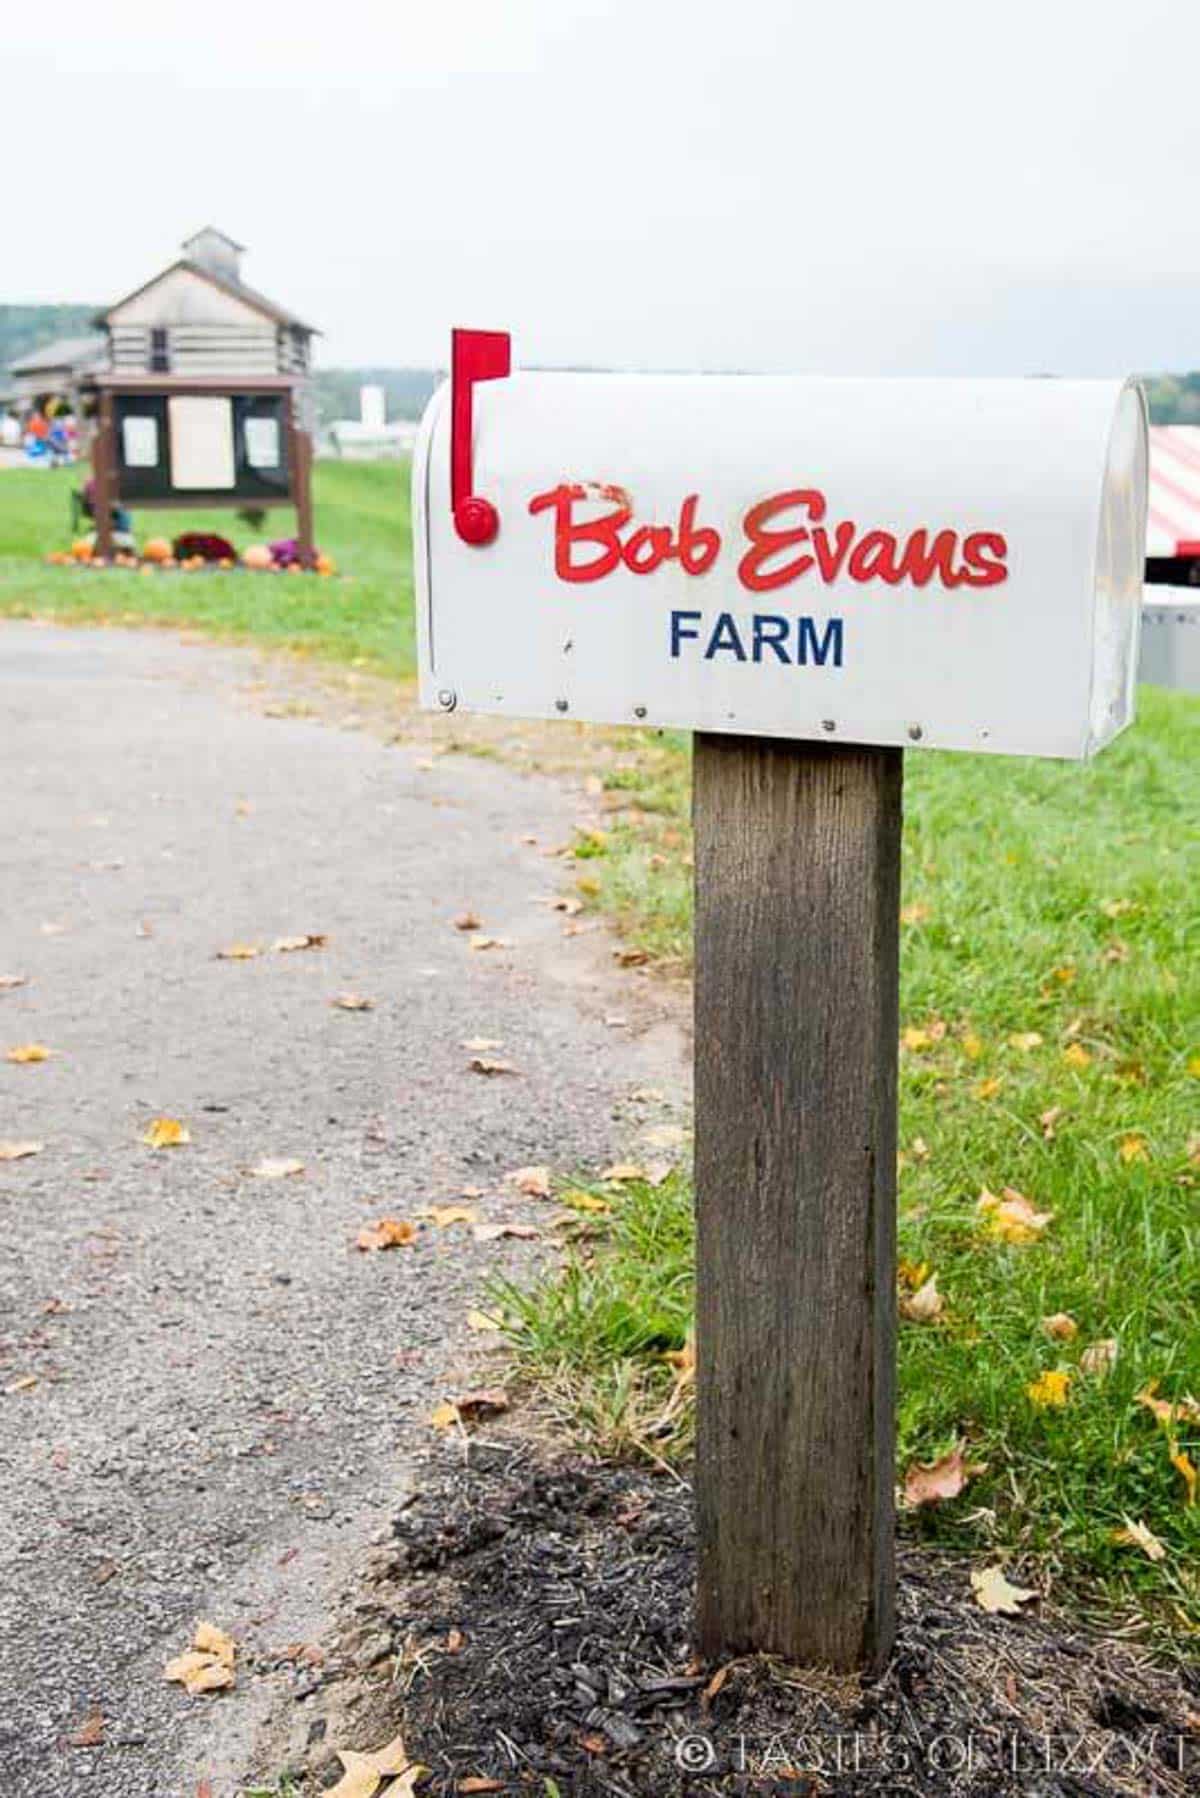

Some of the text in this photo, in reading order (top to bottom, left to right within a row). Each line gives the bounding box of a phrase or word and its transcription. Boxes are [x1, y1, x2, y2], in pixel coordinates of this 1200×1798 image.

[528, 483, 1008, 592] Bob Evans
[669, 609, 845, 667] FARM
